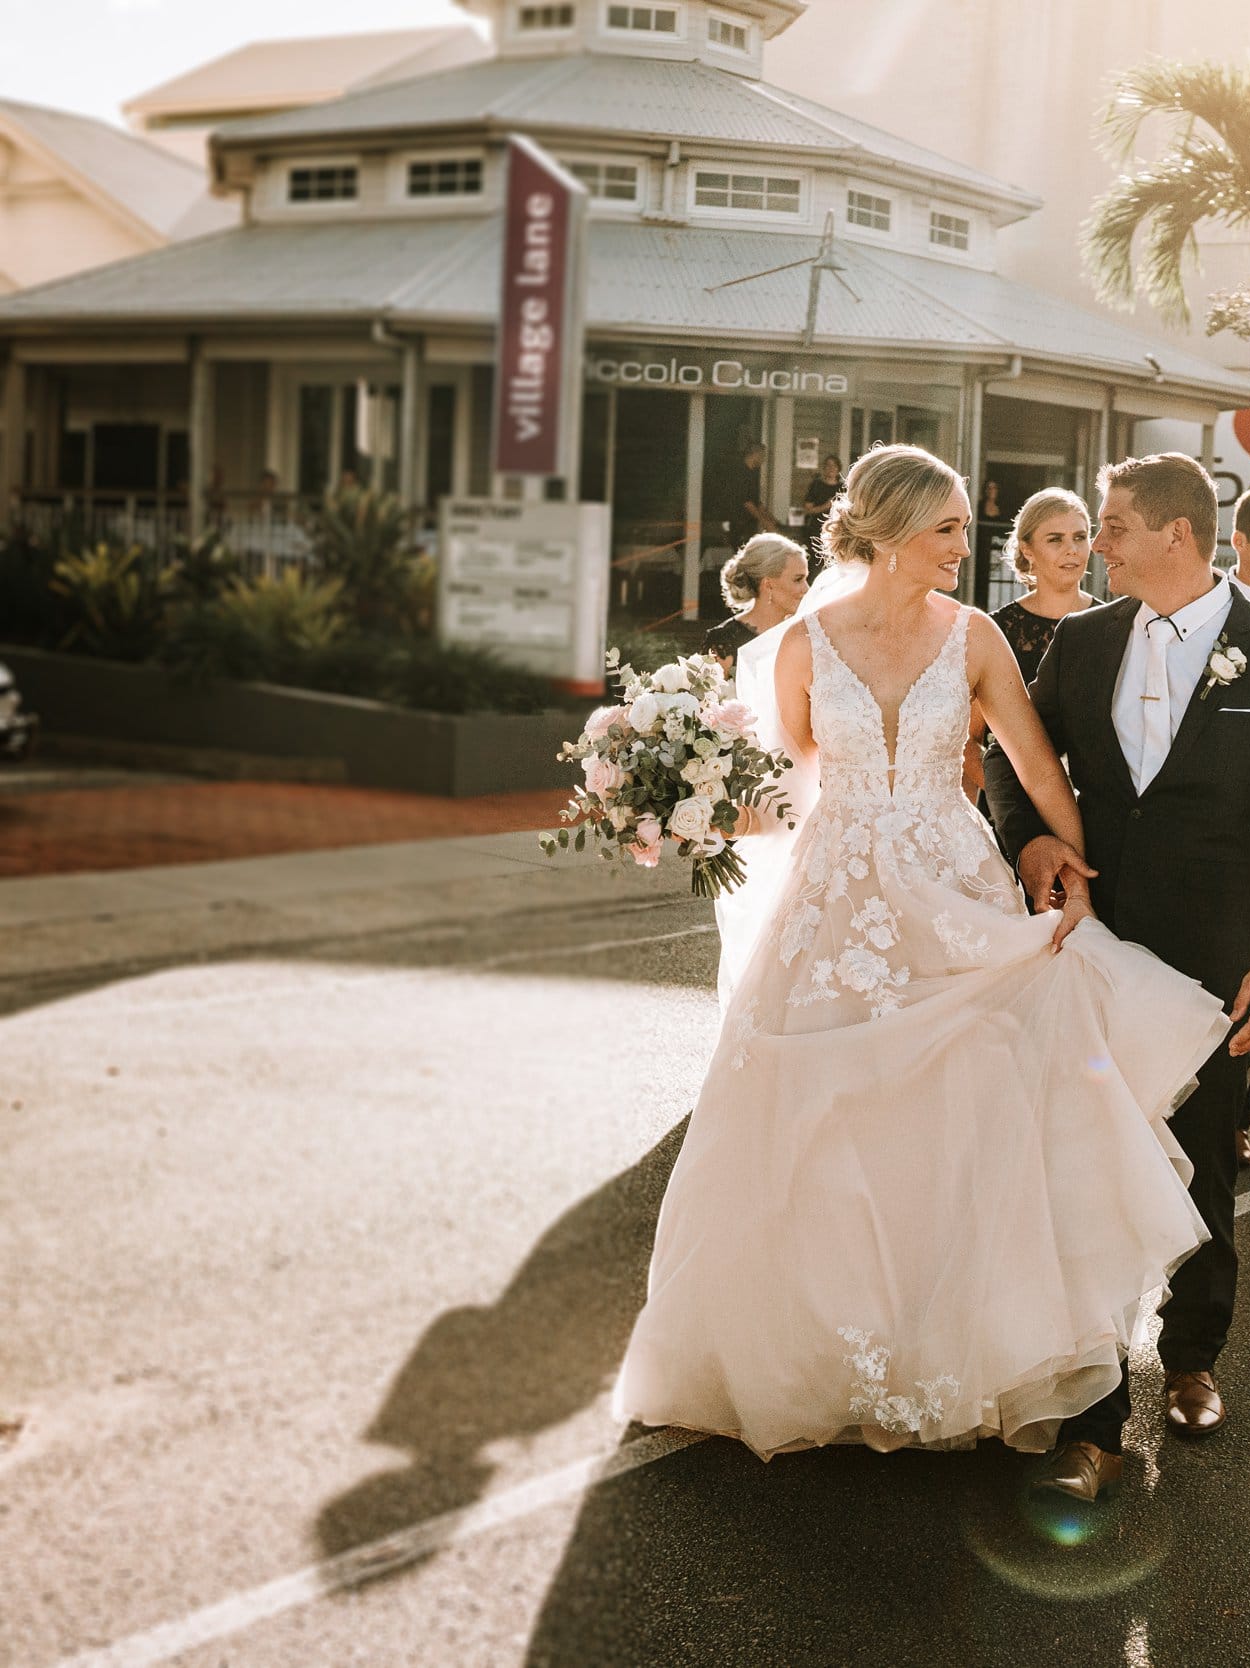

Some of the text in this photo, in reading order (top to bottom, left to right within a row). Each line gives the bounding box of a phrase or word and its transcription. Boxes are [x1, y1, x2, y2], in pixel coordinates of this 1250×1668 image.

[508, 192, 555, 443] village lane
[586, 357, 848, 394] iccolo Cucina
